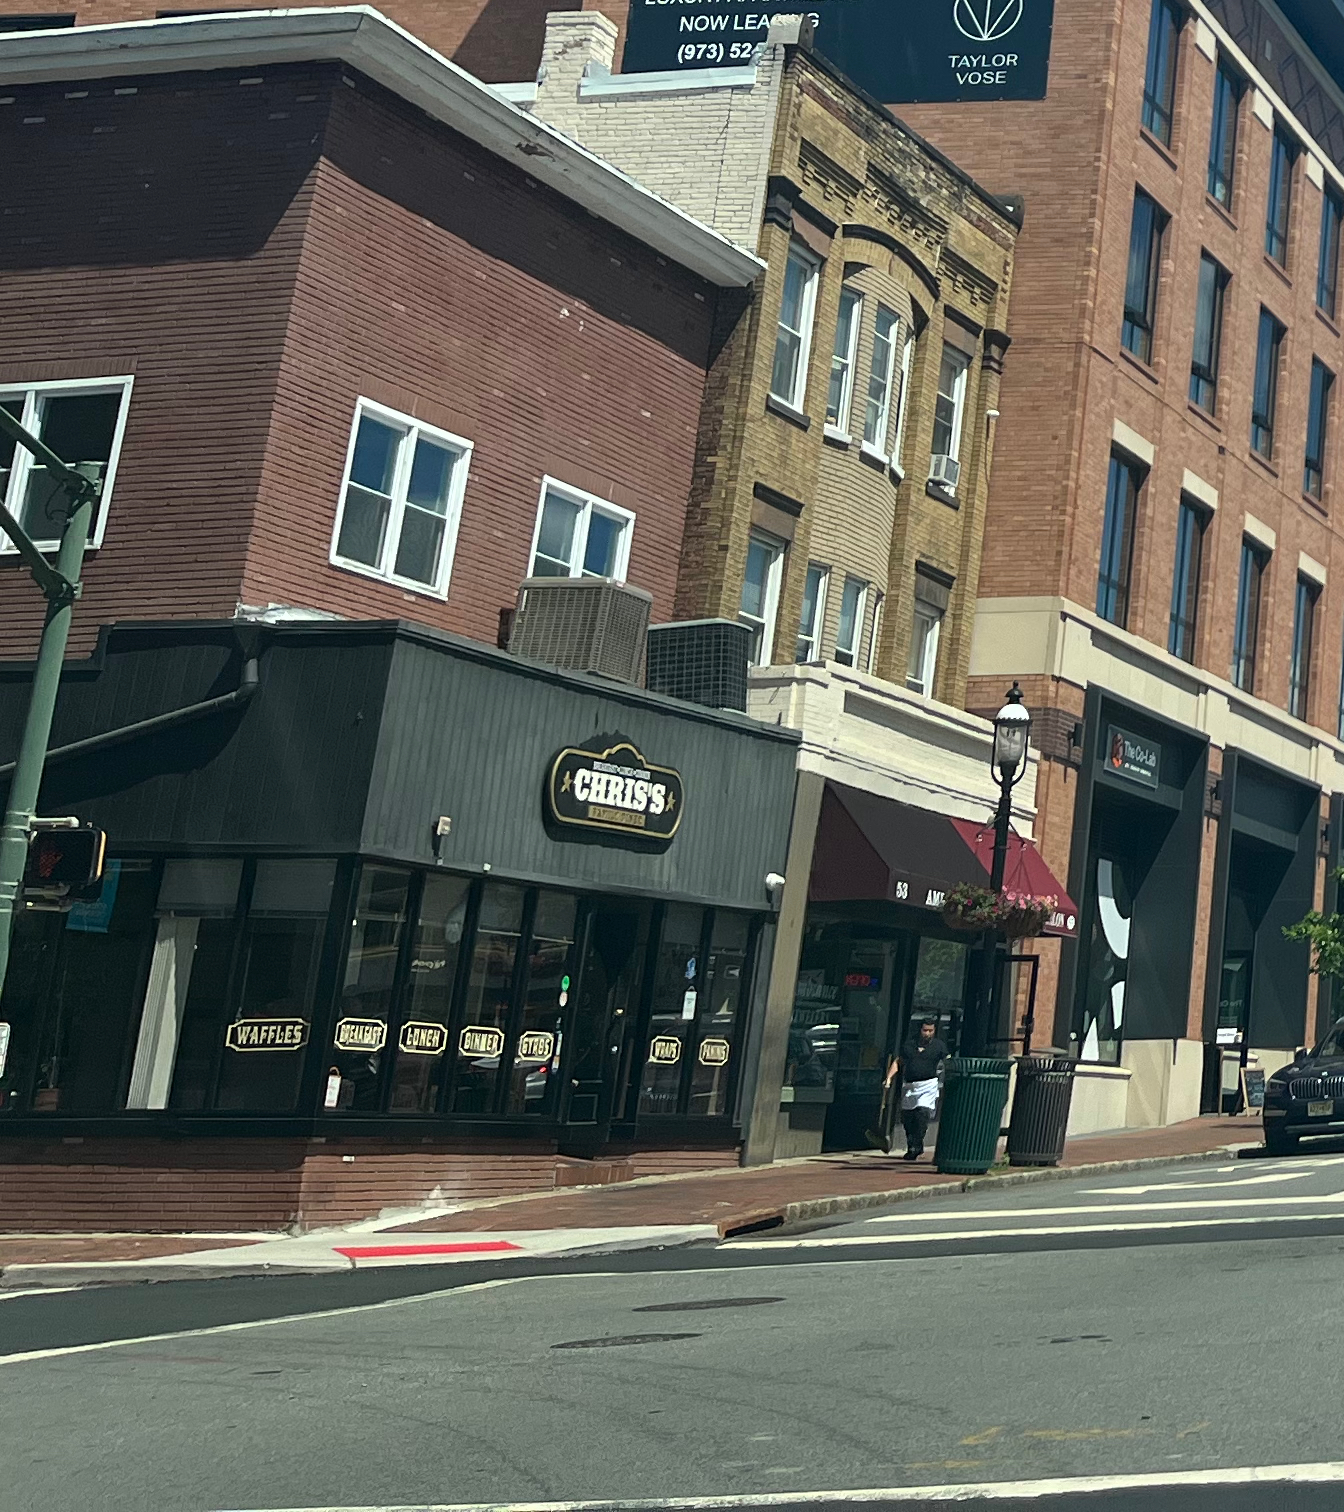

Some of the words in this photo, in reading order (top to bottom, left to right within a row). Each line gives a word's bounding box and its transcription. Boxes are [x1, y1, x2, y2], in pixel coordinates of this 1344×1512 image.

[679, 15, 728, 32] NOW
[733, 13, 820, 31] LEAG
[677, 42, 725, 63] (973)
[947, 53, 1018, 69] TAYLOR
[956, 70, 1007, 85] VOSE
[1124, 740, 1136, 760] The
[1135, 745, 1157, 767] Co-Lab
[574, 768, 666, 815] CHRIS'S
[896, 881, 909, 899] 53
[925, 889, 946, 906] AME
[237, 1024, 303, 1045] WAFFLES
[339, 1024, 383, 1045] BREAKFAST
[406, 1027, 440, 1048] LUNCH
[463, 1032, 499, 1053] DINNER
[522, 1038, 550, 1056] GYROS
